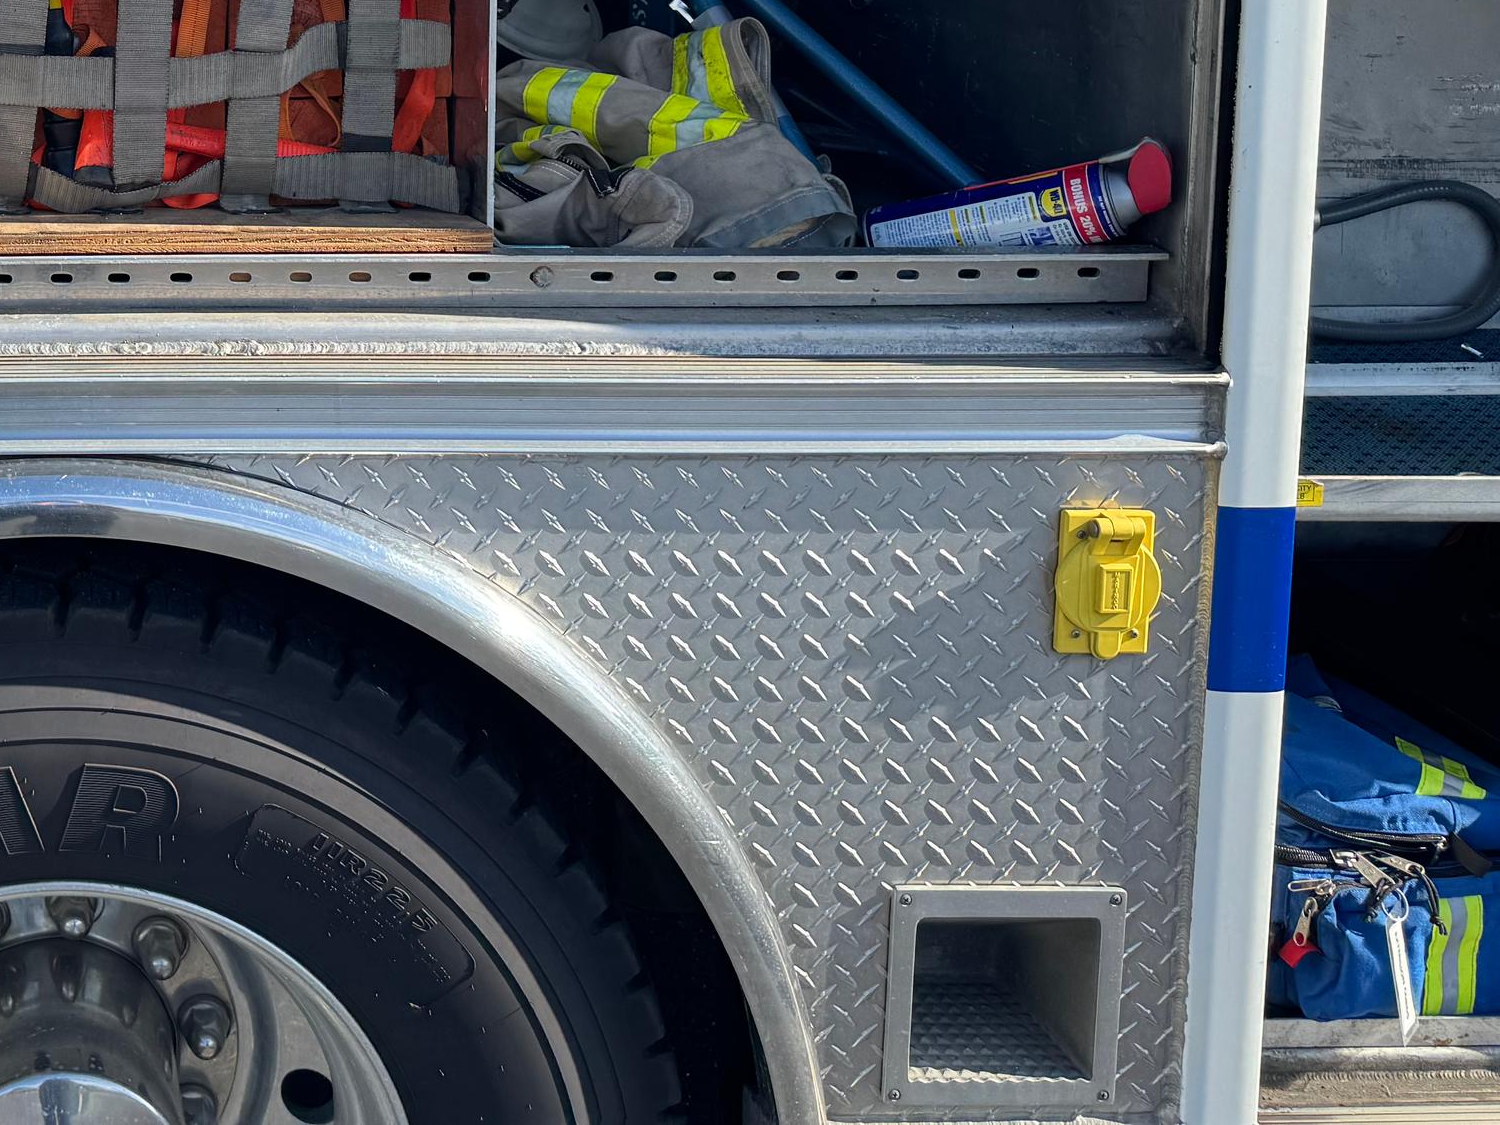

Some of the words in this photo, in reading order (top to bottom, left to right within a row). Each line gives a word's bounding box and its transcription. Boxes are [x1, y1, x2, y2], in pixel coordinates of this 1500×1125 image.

[1049, 189, 1063, 214] WD-40
[1070, 178, 1088, 214] BONUS
[1079, 215, 1097, 236] 20%
